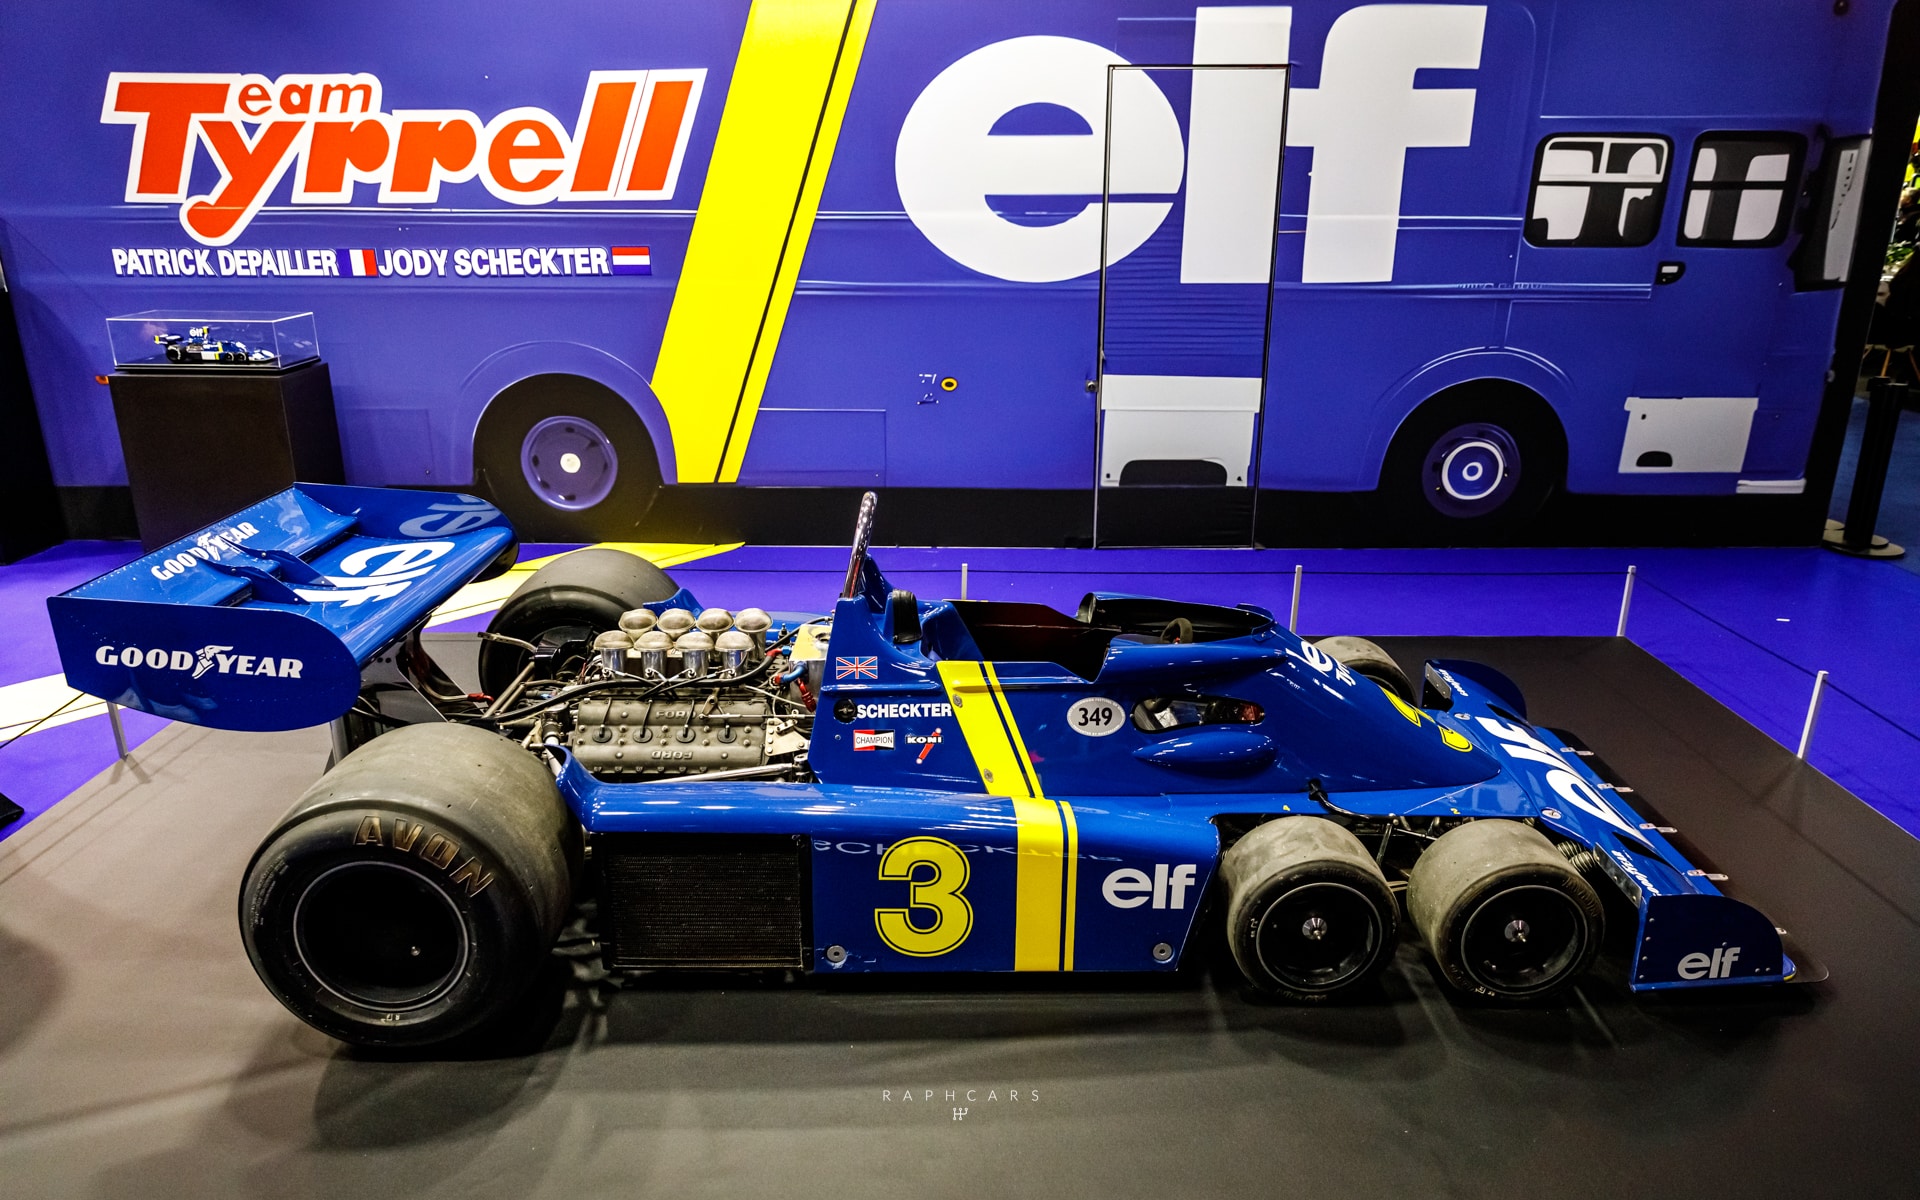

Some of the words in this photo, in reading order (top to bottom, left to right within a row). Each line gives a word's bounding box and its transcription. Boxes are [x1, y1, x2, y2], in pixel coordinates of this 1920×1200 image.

[106, 70, 704, 244] Tyrrell
[895, 5, 1488, 284] elf
[111, 248, 217, 277] PATRICK
[217, 248, 340, 277] DEPAILLER
[378, 248, 449, 277] JODY
[453, 247, 610, 277] SCHECKTER
[293, 541, 456, 608] elf
[656, 710, 697, 719] FORD
[857, 703, 952, 719] SCHECKTER
[1078, 707, 1113, 727] 349
[651, 750, 693, 760] FORD
[855, 736, 894, 745] CHAMPION
[907, 736, 942, 744] KONI
[353, 815, 495, 898] AVON
[874, 836, 974, 957] 3
[1102, 863, 1197, 910] elf
[1677, 946, 1741, 980] elf
